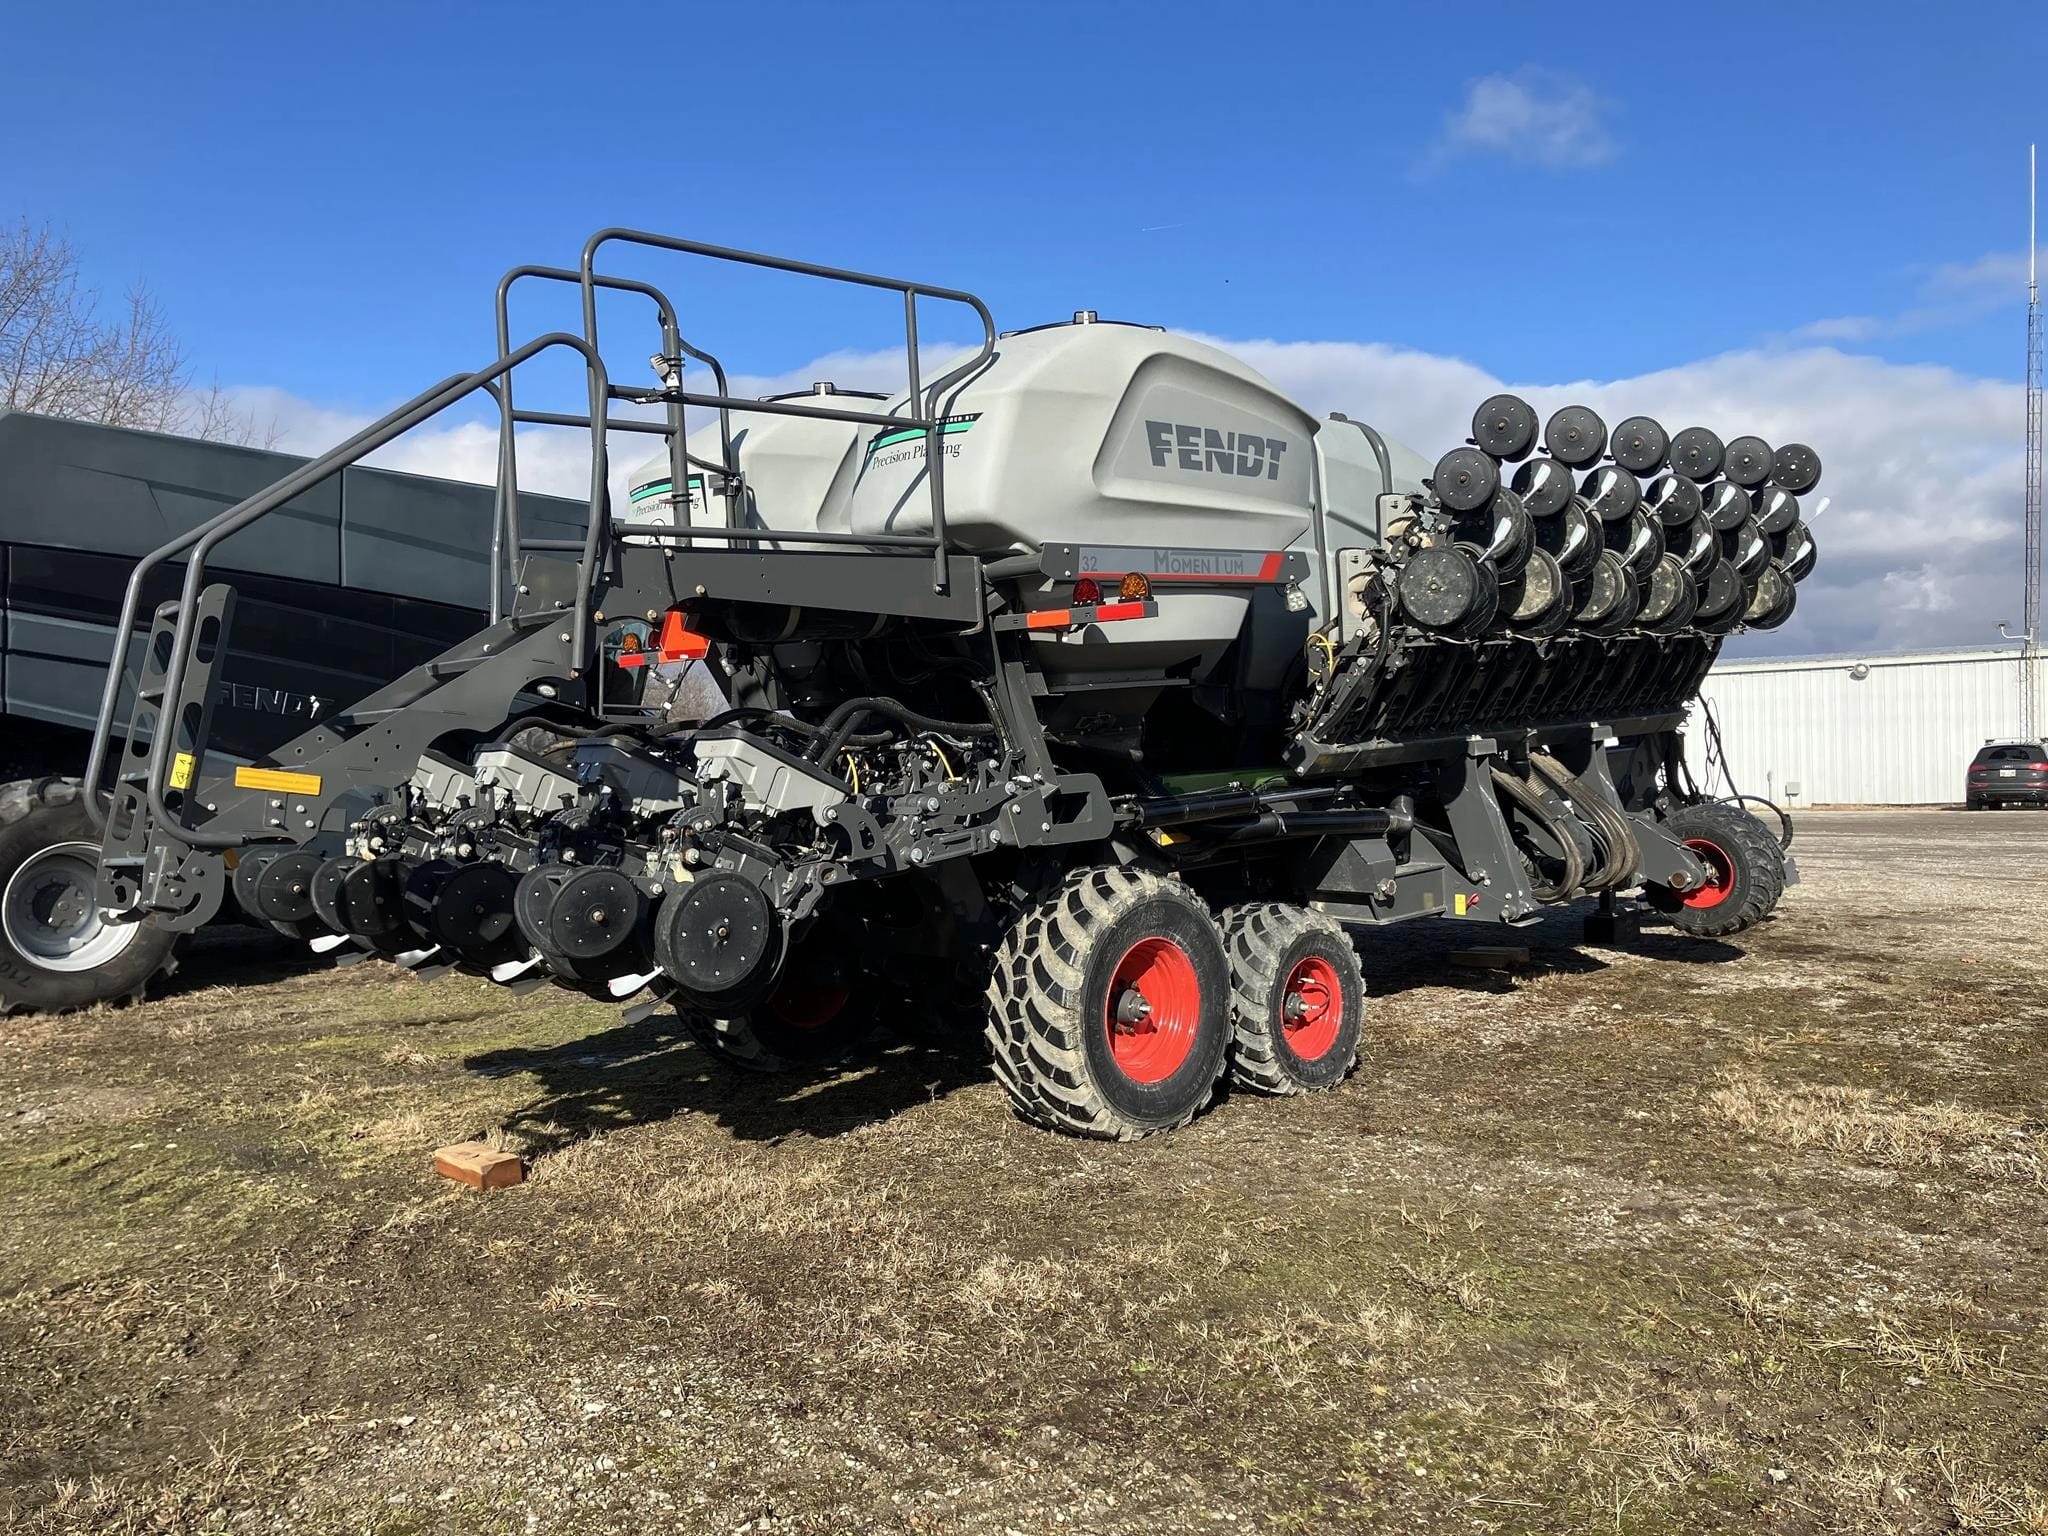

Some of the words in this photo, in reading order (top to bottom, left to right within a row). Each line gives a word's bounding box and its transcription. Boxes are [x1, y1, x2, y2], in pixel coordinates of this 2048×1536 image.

[872, 449, 911, 470] Precision
[1145, 420, 1287, 481] FENDT
[1082, 555, 1098, 572] 32
